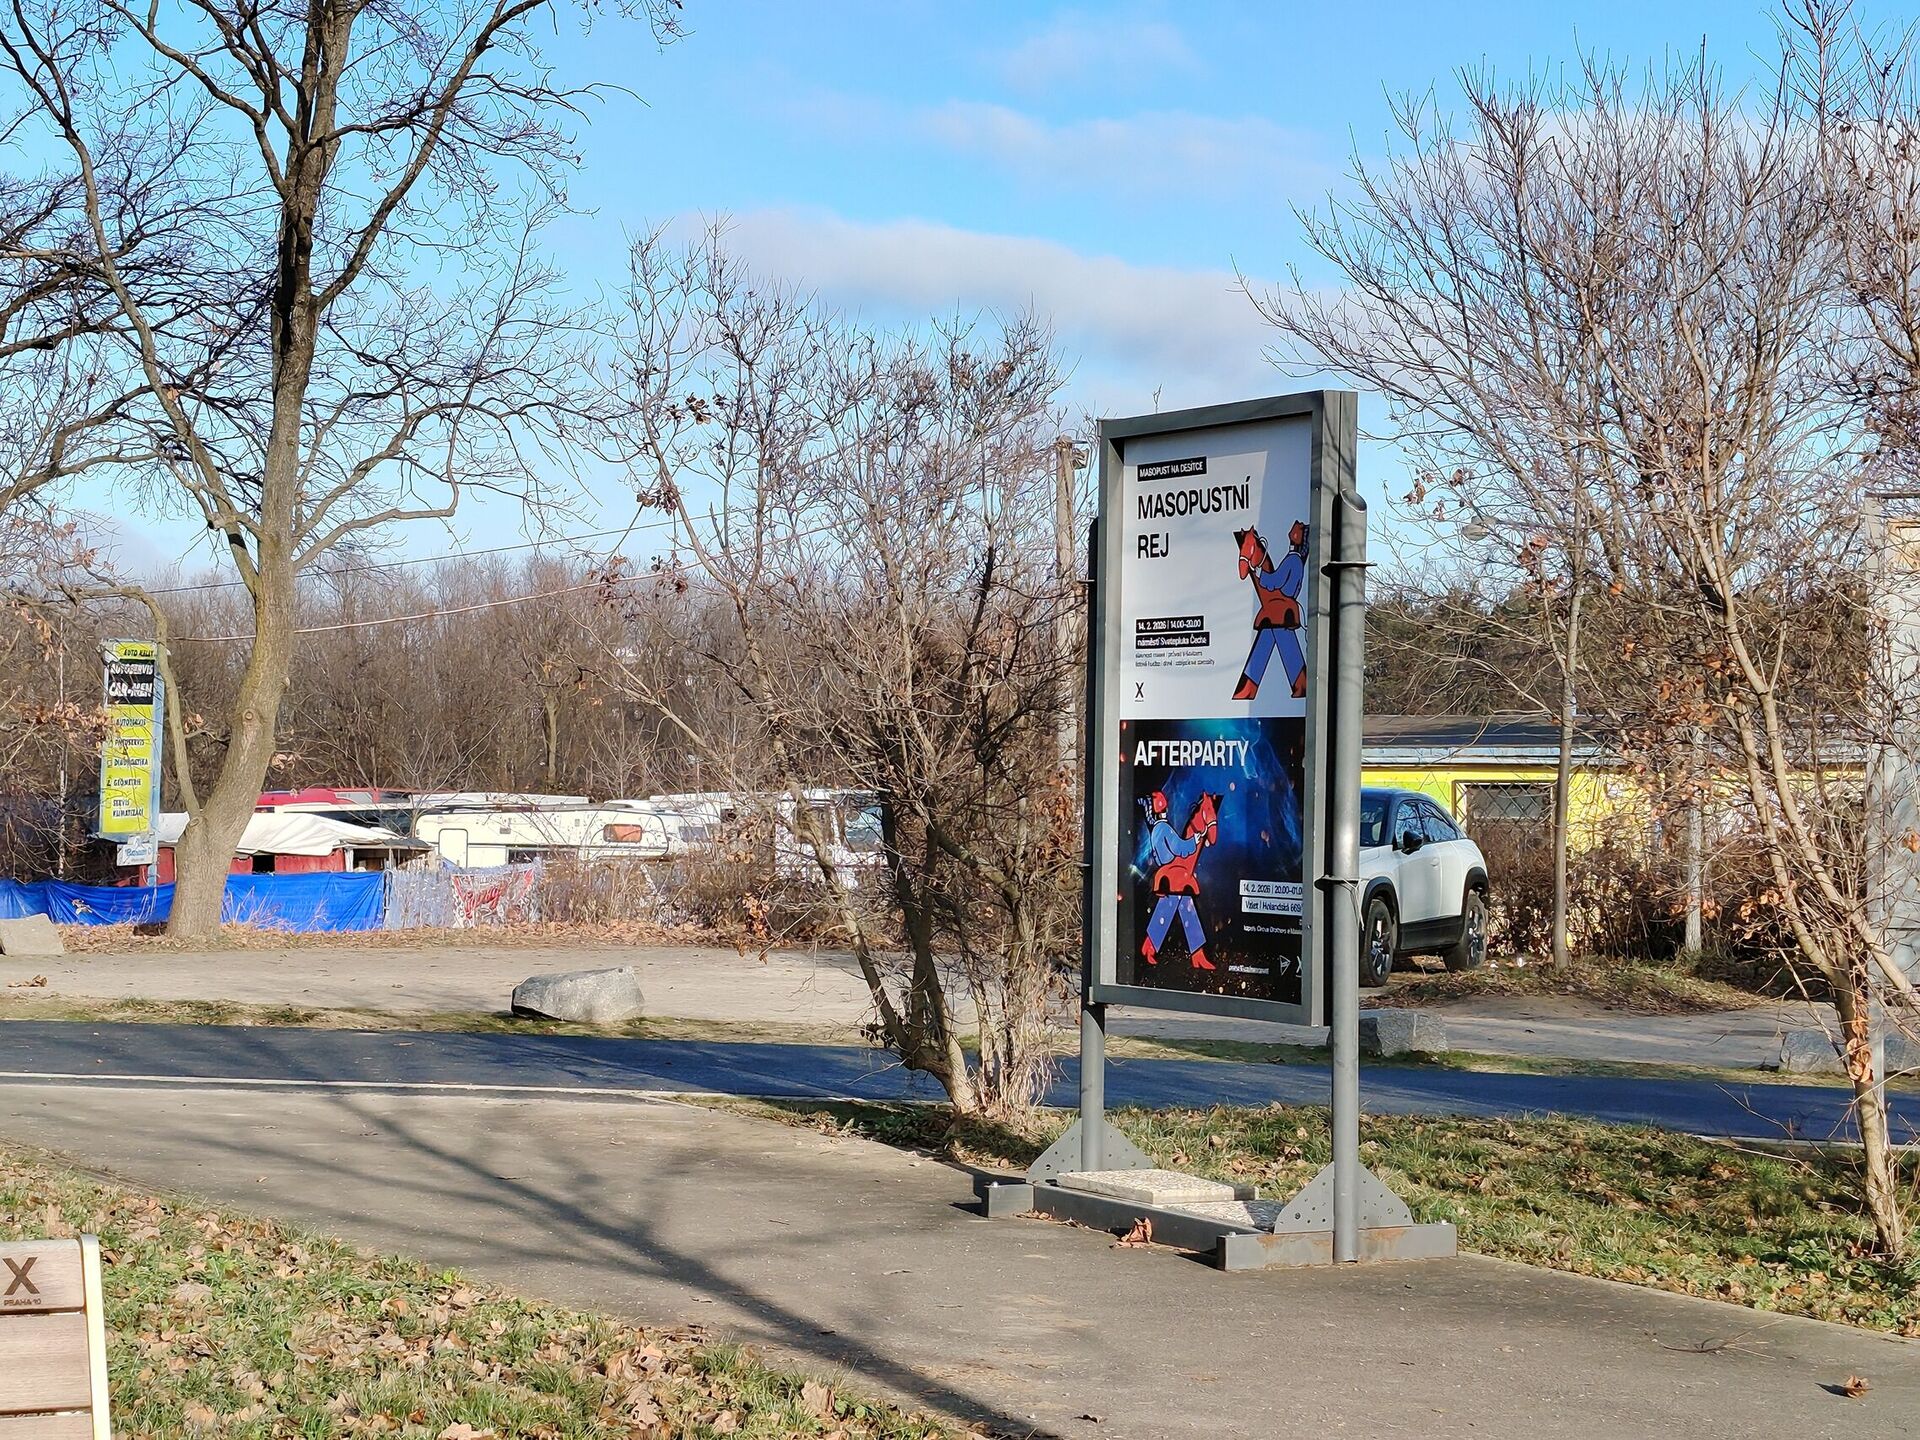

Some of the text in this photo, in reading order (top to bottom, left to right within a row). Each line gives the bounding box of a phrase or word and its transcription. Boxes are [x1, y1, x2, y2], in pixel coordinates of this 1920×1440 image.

[1139, 460, 1204, 477] MASOPUST NA DESÍTCE
[1138, 476, 1251, 520] MASOPUSTNÍ
[1137, 532, 1170, 559] REJ
[123, 649, 138, 657] AUTO
[110, 663, 153, 675] AUTOSERVIS
[1135, 682, 1144, 698] X
[1134, 740, 1249, 767] AFTERPARTY
[2, 1256, 40, 1295] X
